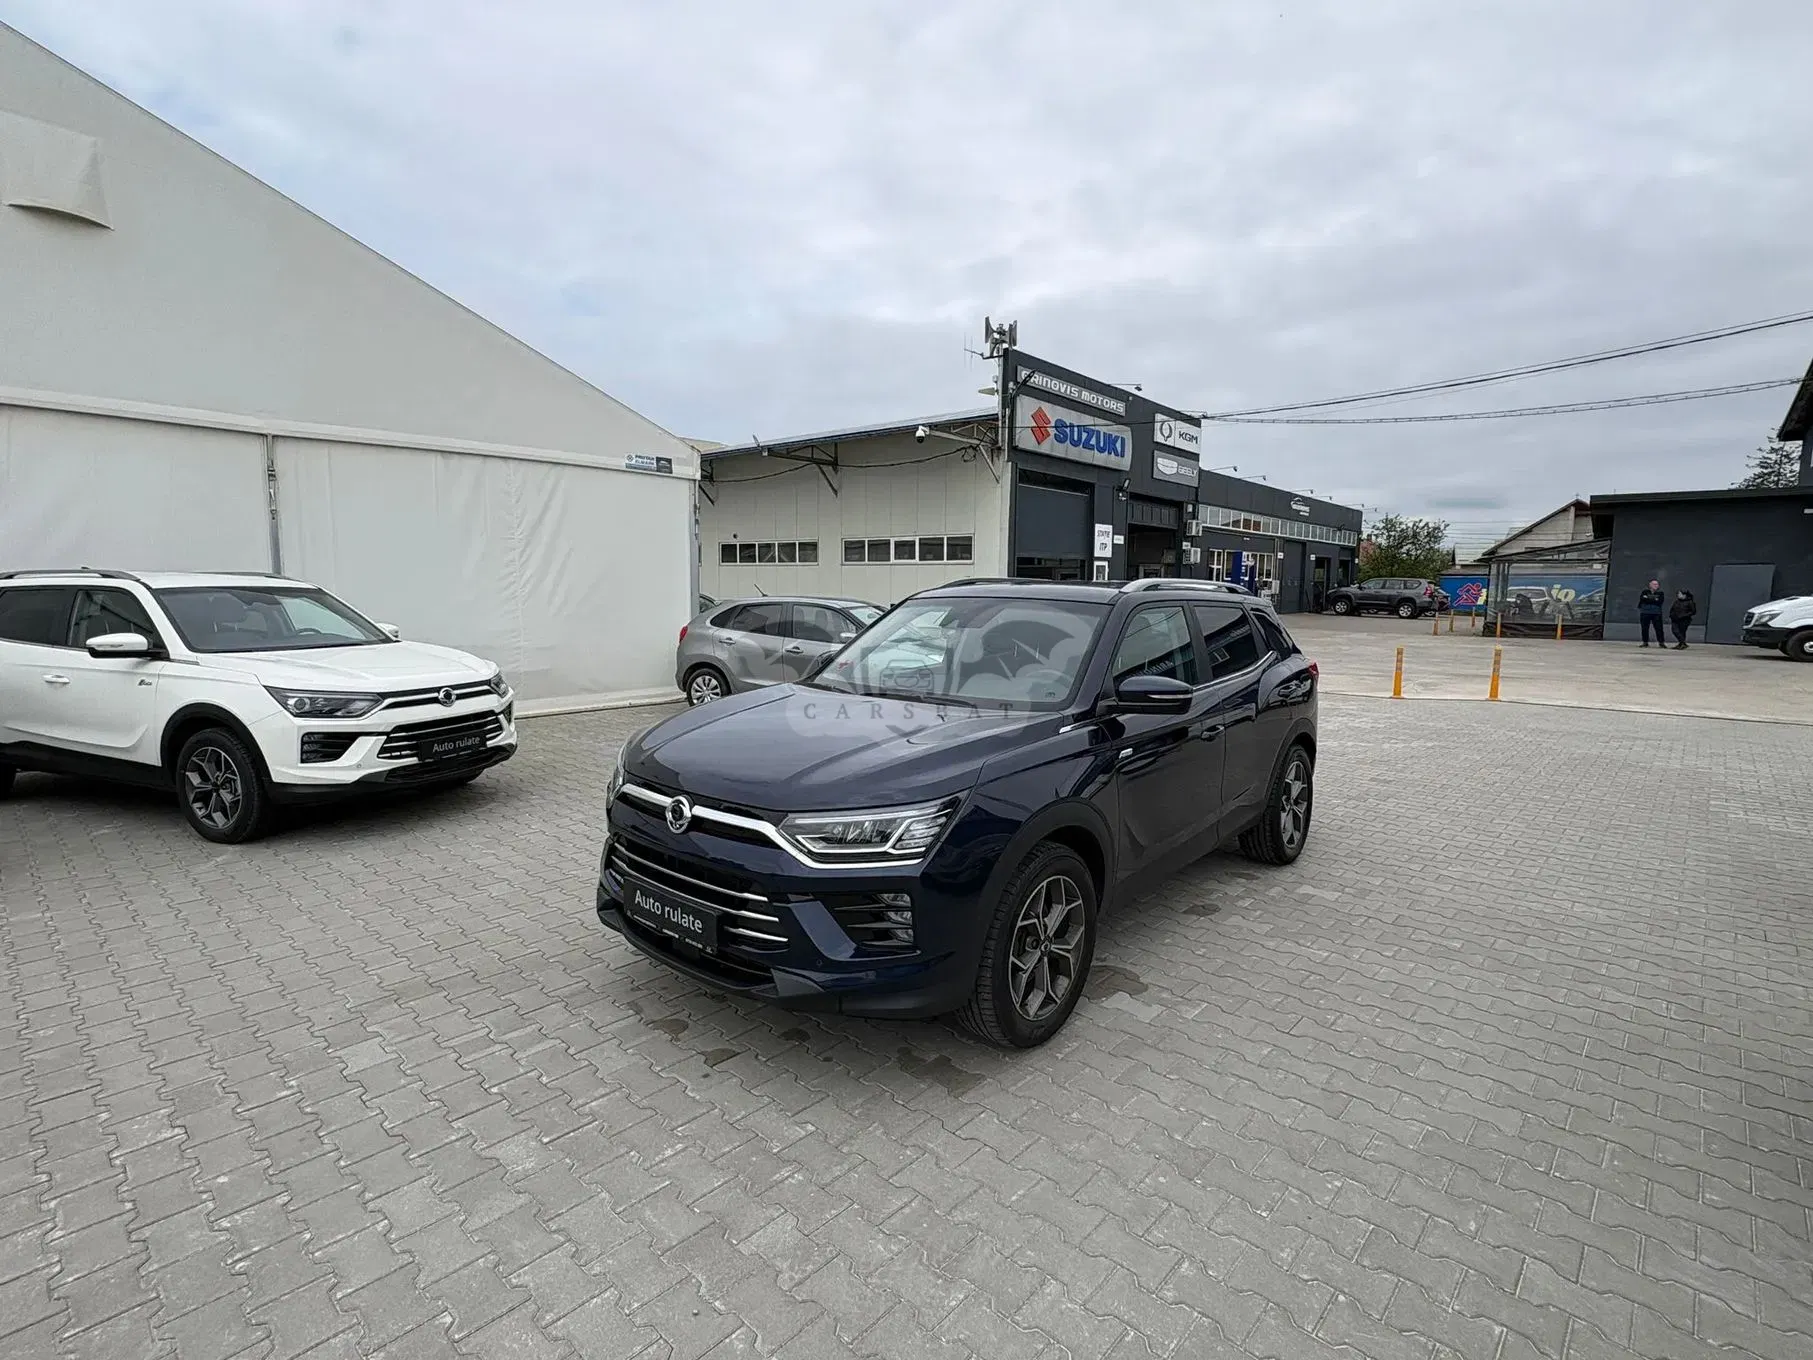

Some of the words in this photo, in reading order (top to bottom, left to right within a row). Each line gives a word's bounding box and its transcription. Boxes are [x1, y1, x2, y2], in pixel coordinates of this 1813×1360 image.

[1081, 390, 1124, 413] MOTORS
[1054, 418, 1126, 458] SUZUKI
[1178, 430, 1198, 444] KGM
[432, 742, 454, 753] Auto
[456, 736, 481, 748] rulate
[634, 889, 662, 915] Auto
[664, 905, 703, 934] rulate
